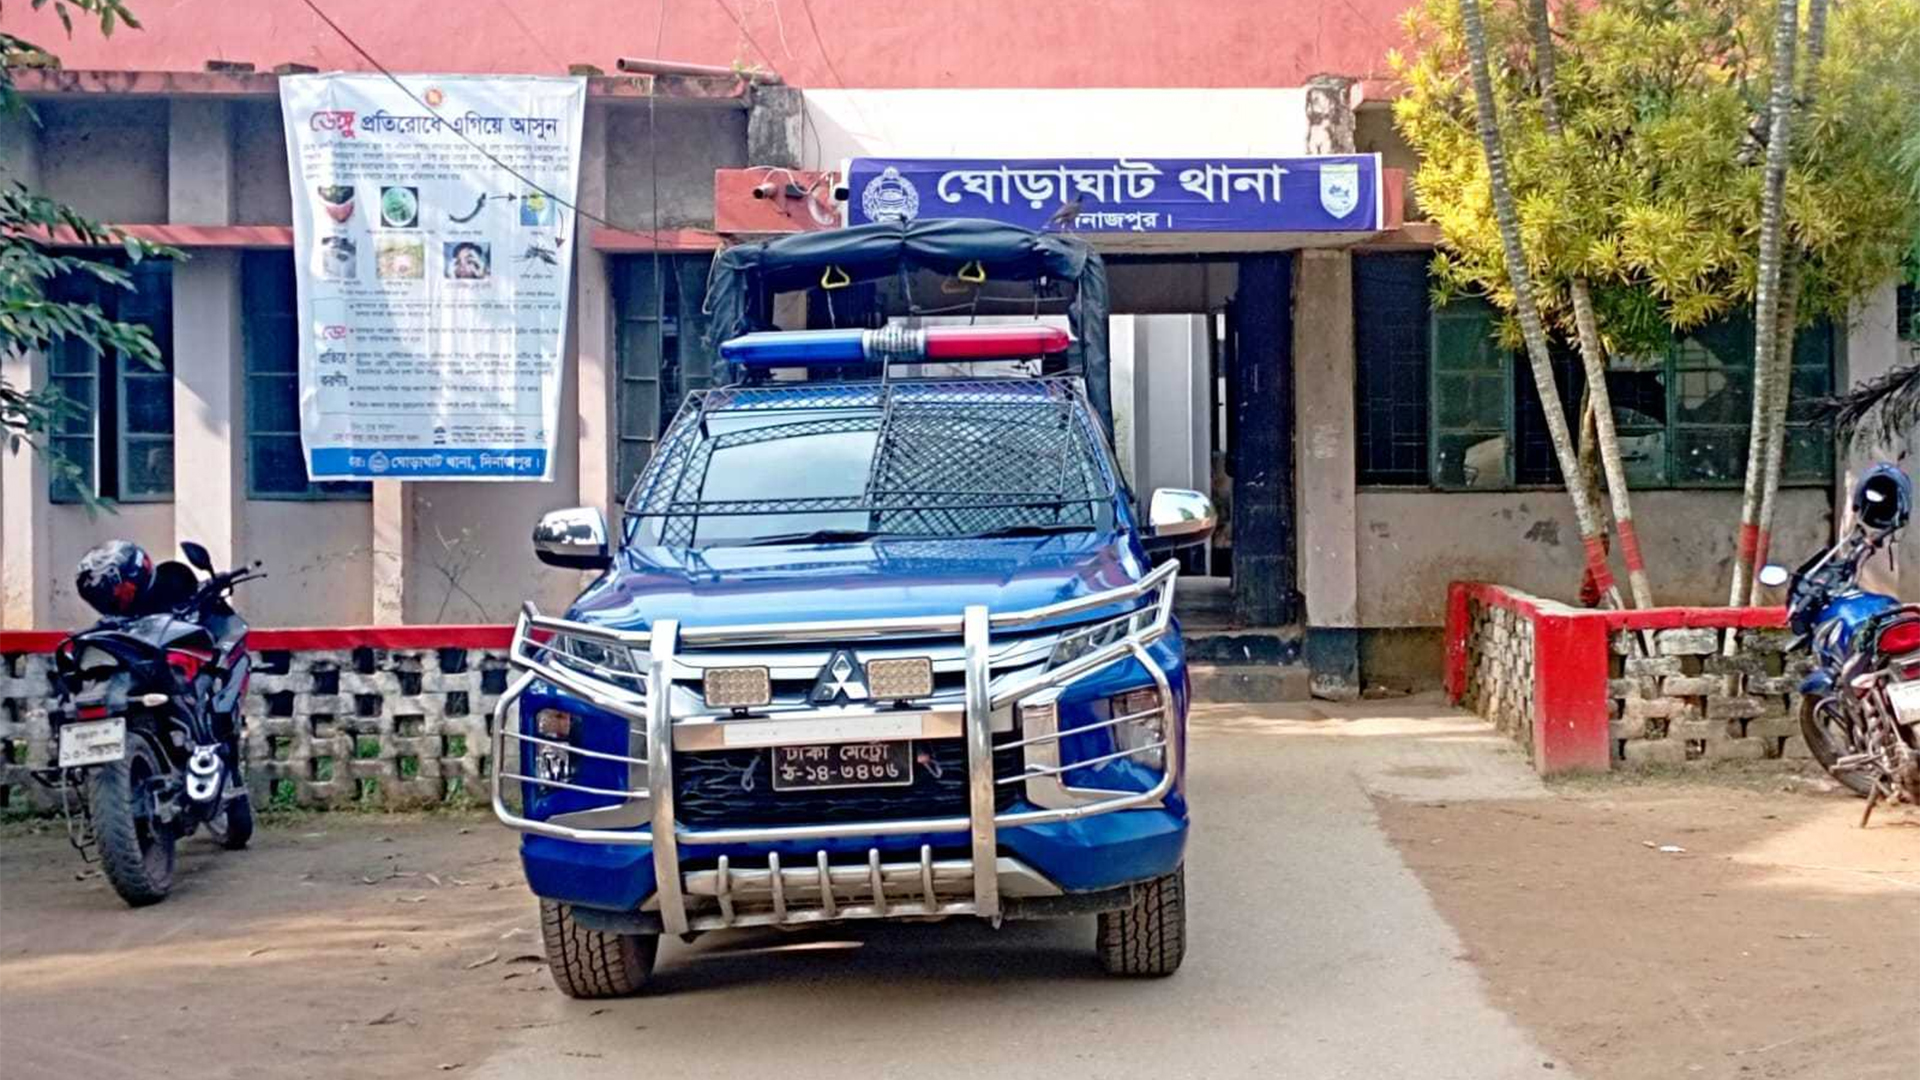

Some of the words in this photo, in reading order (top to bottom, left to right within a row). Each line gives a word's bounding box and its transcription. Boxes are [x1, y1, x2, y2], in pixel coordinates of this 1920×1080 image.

[310, 107, 356, 139] ডেঙ্গু
[361, 109, 442, 134] প্রতিরোধে
[453, 111, 504, 136] এগিয়ে
[509, 117, 559, 141] আসুন
[937, 157, 1164, 210] ঘোড়াঘাট
[1178, 163, 1290, 203] থানা
[1074, 211, 1160, 231] নাজপুর
